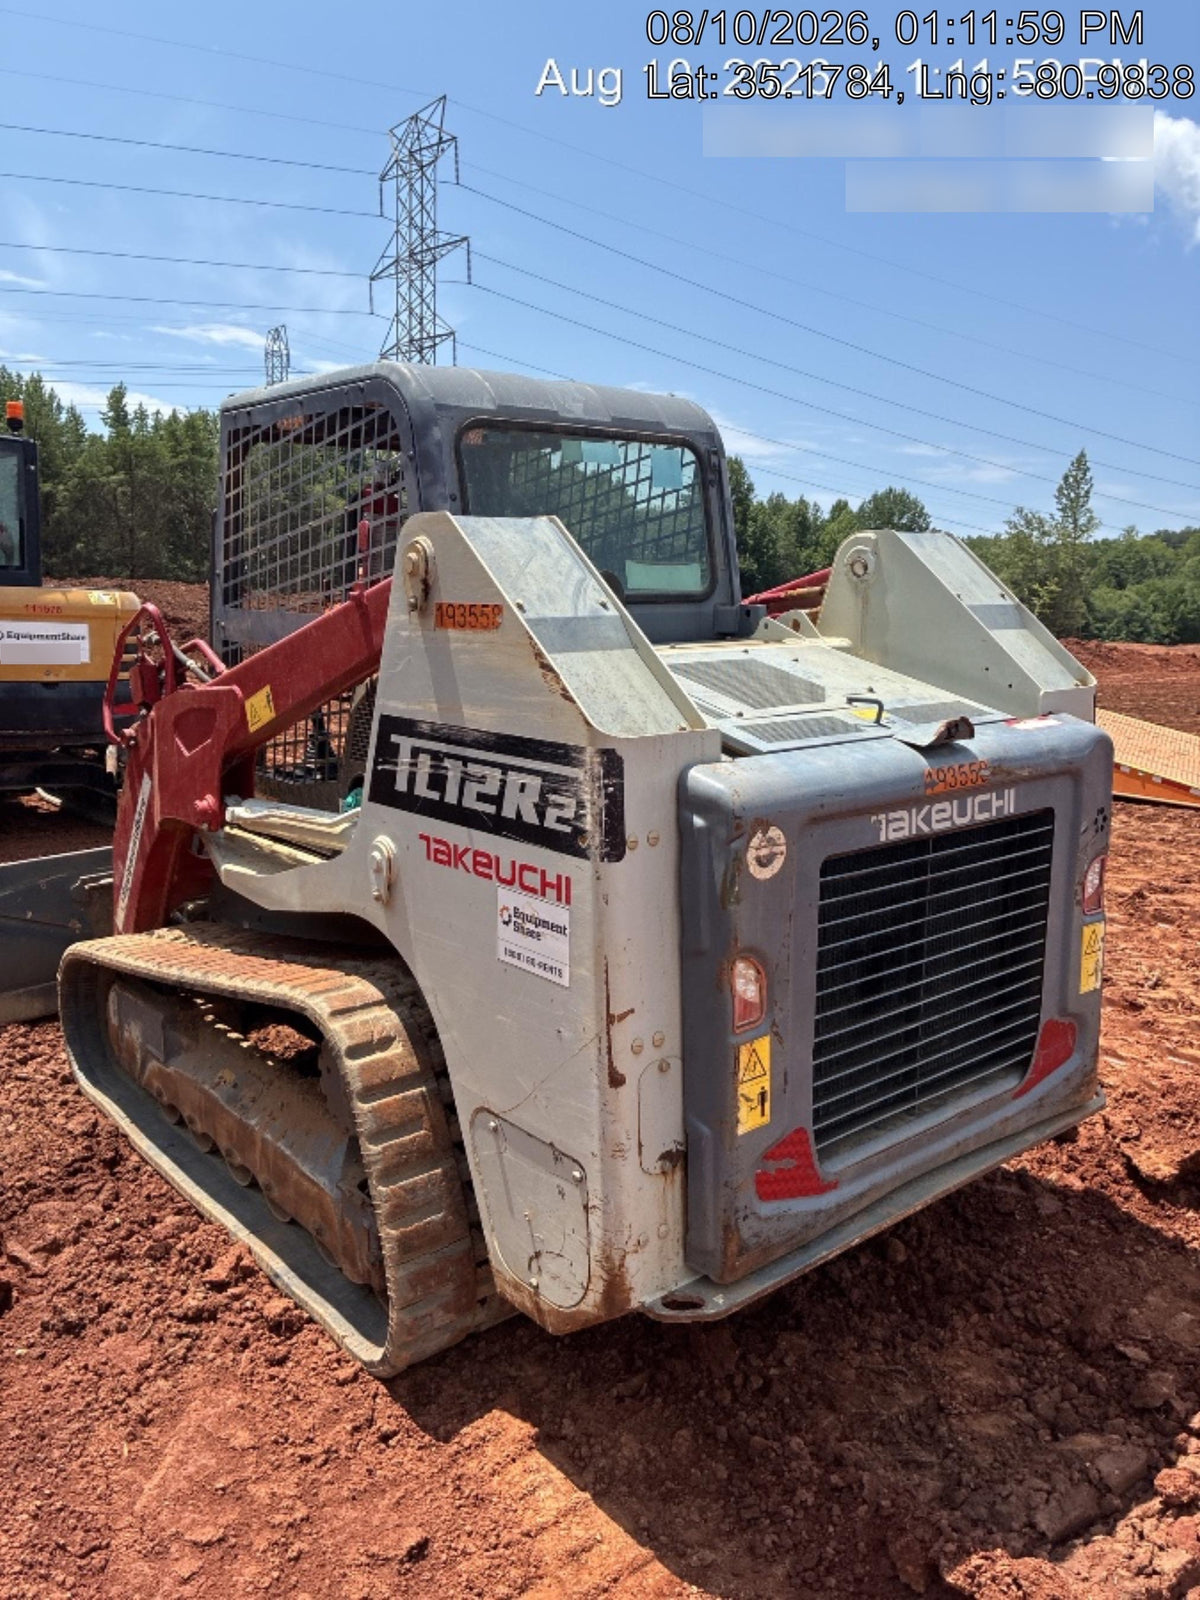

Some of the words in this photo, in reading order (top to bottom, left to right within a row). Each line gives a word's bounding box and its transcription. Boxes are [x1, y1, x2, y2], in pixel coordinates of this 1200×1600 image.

[418, 832, 572, 905] TAKEUCHI
[513, 906, 568, 937] Equipment
[513, 920, 541, 941] Share
